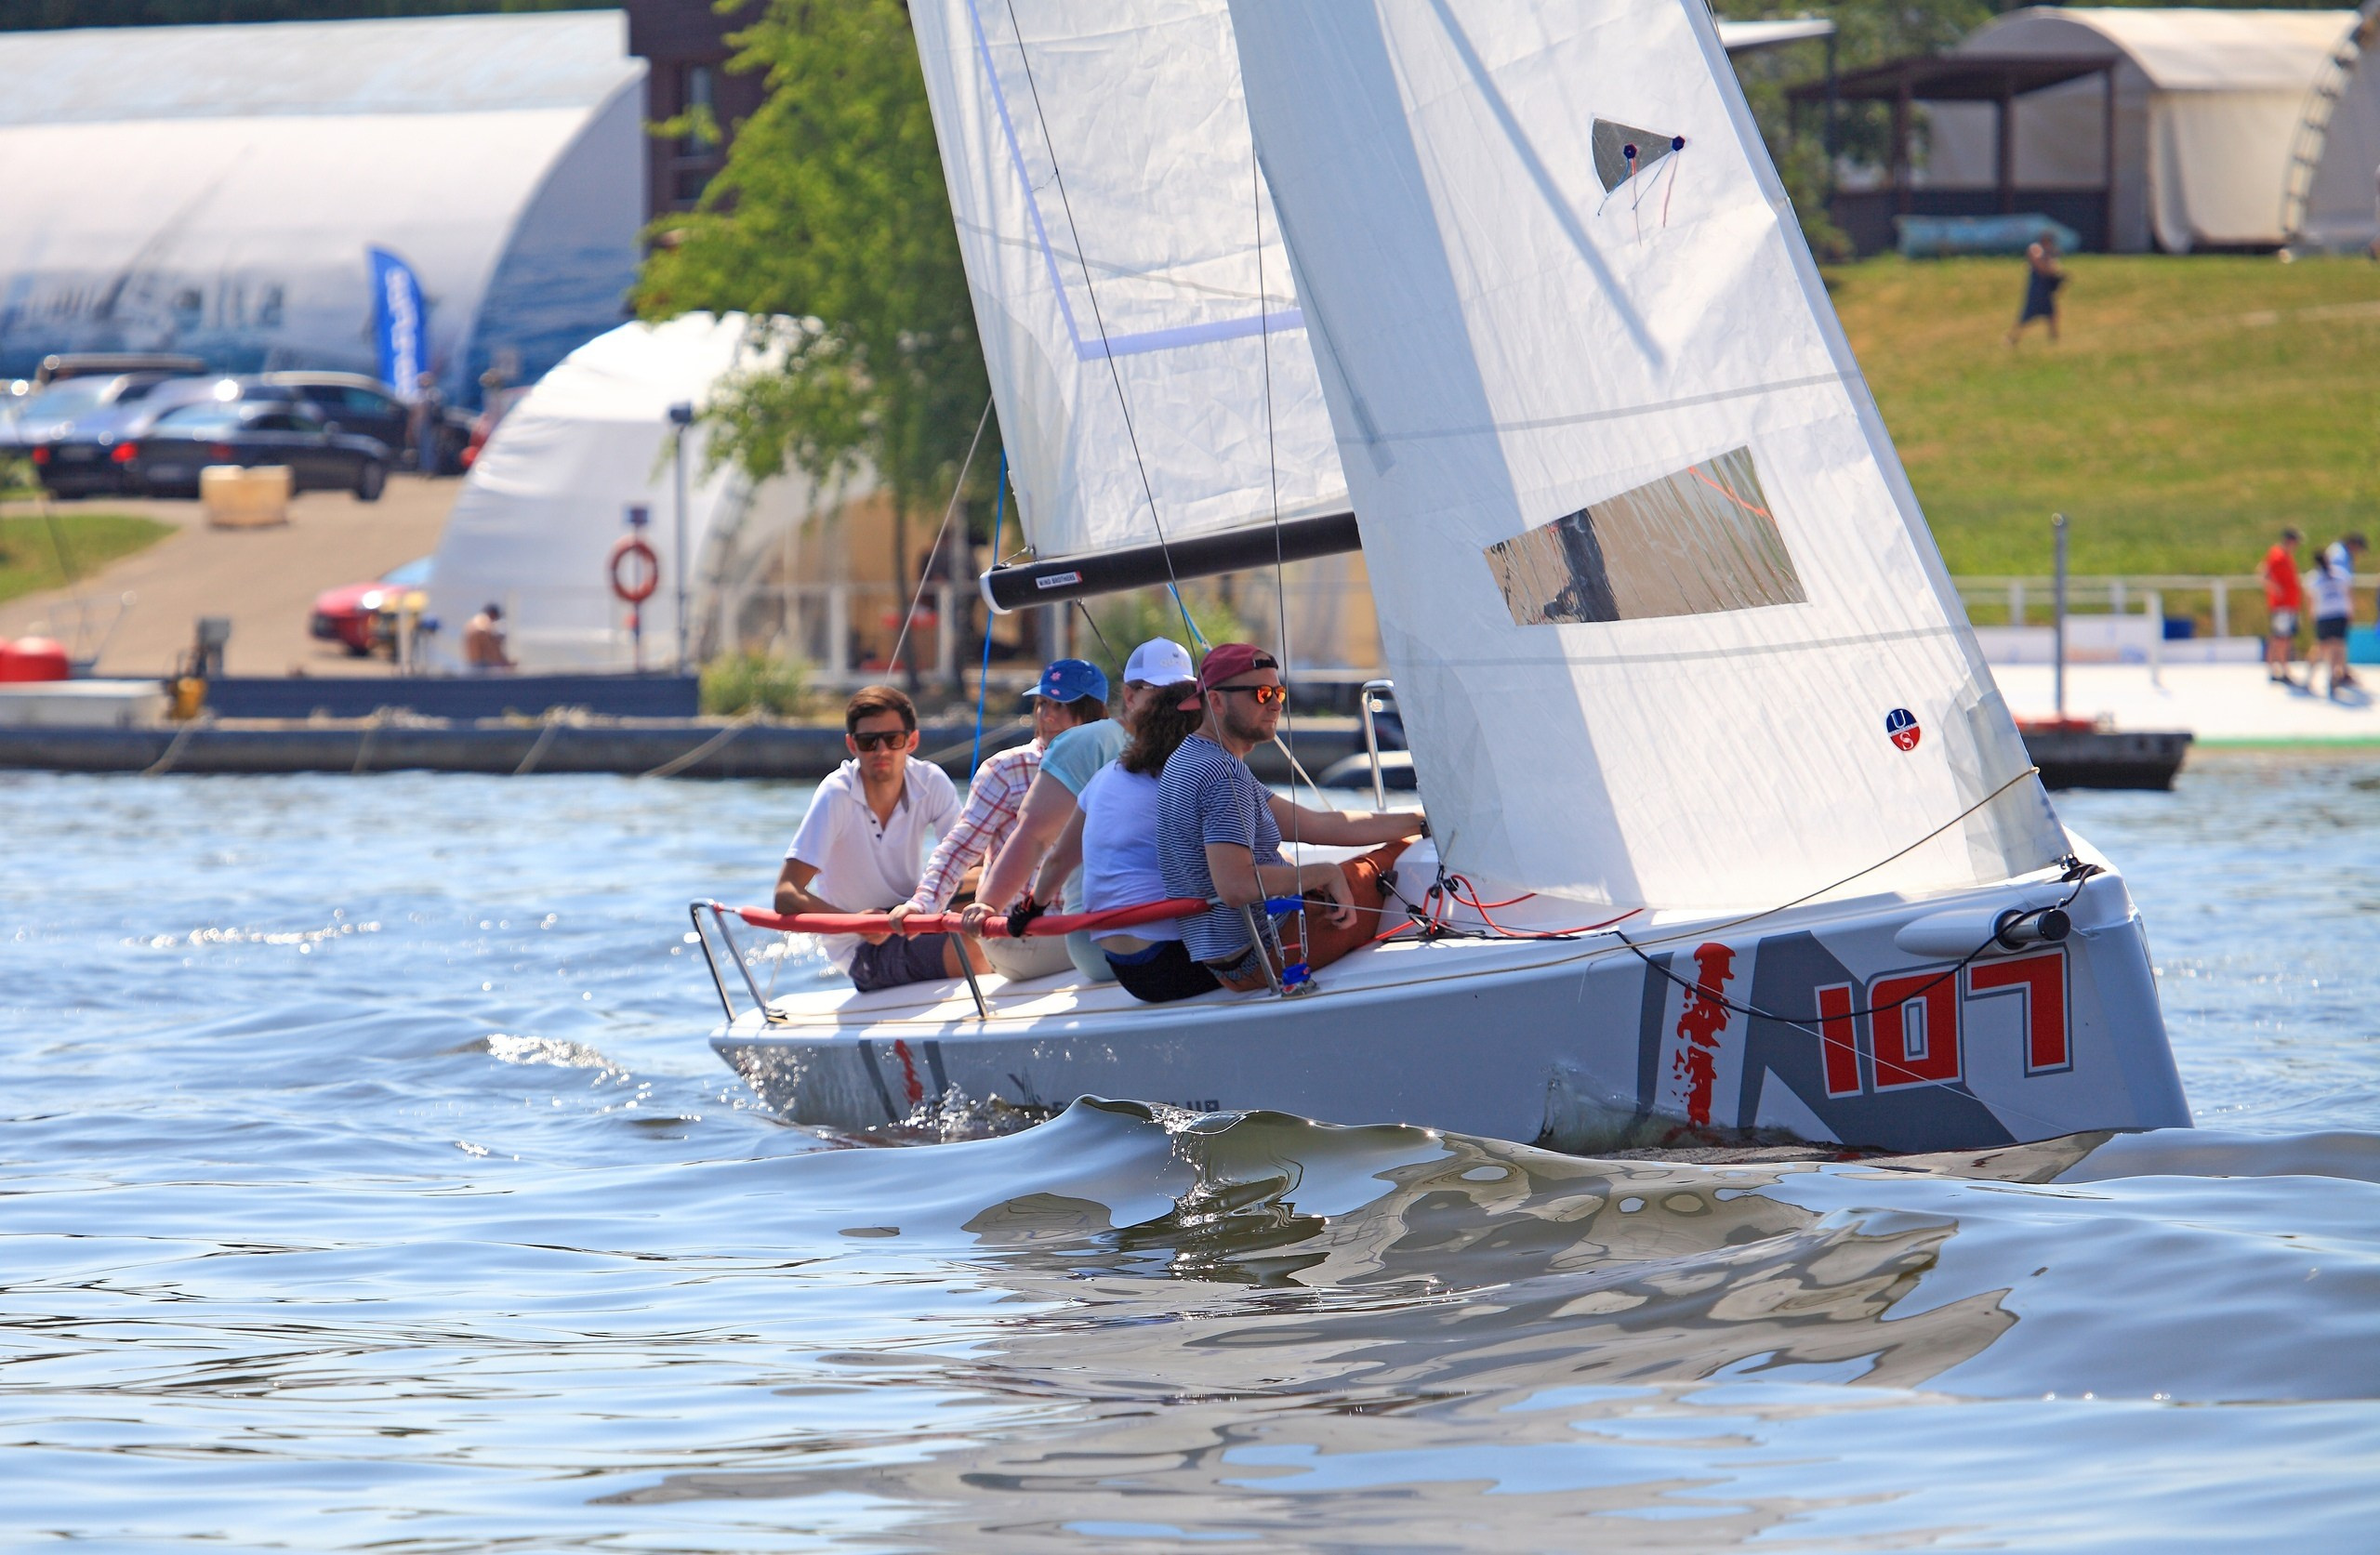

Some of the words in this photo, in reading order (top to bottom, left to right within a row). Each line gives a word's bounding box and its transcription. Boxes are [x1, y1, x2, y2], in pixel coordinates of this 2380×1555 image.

[1890, 710, 1906, 728] U
[1899, 732, 1913, 750] S
[1815, 943, 2073, 1100] 107
